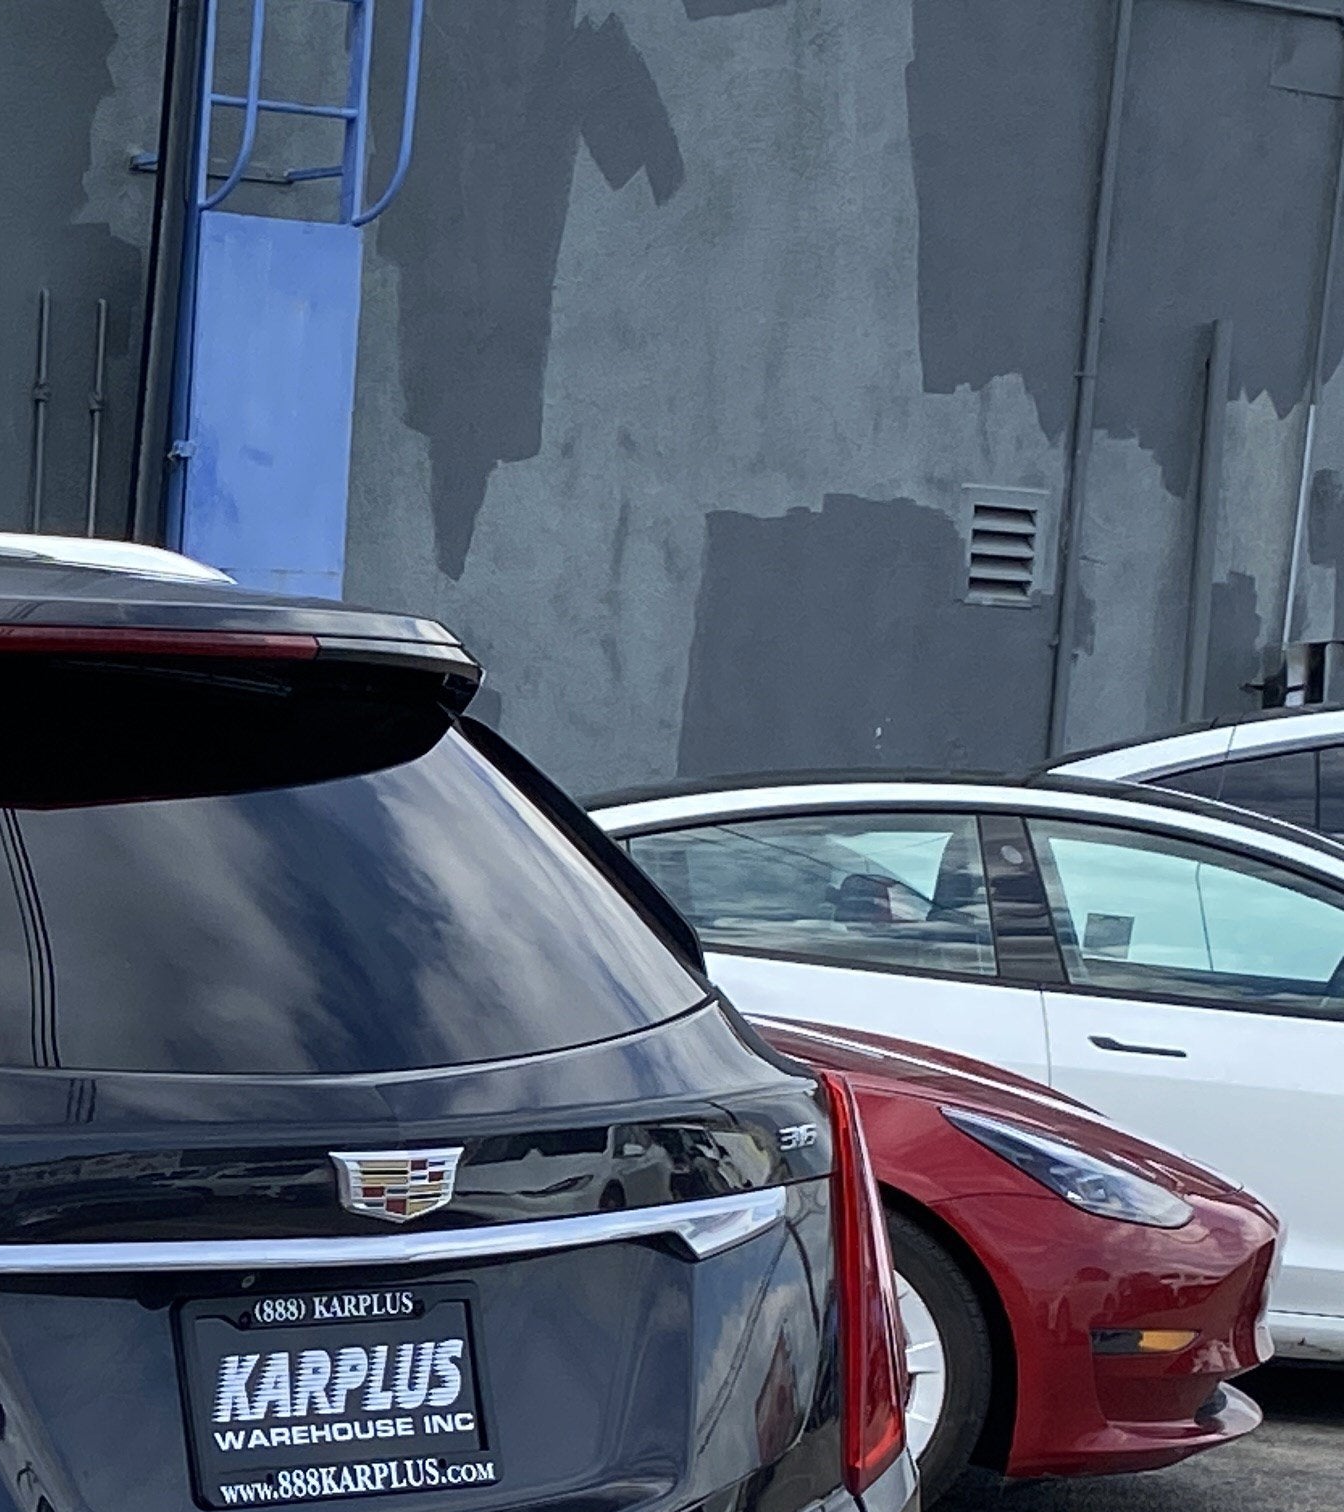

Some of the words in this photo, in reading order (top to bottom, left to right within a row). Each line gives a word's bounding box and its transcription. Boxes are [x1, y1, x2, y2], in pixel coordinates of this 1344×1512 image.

[255, 1299, 306, 1323] (888)
[313, 1292, 413, 1320] KARPLUS
[212, 1339, 463, 1422] KARPLUS
[214, 1417, 415, 1451] WAREHOUSE
[423, 1412, 475, 1434] INC
